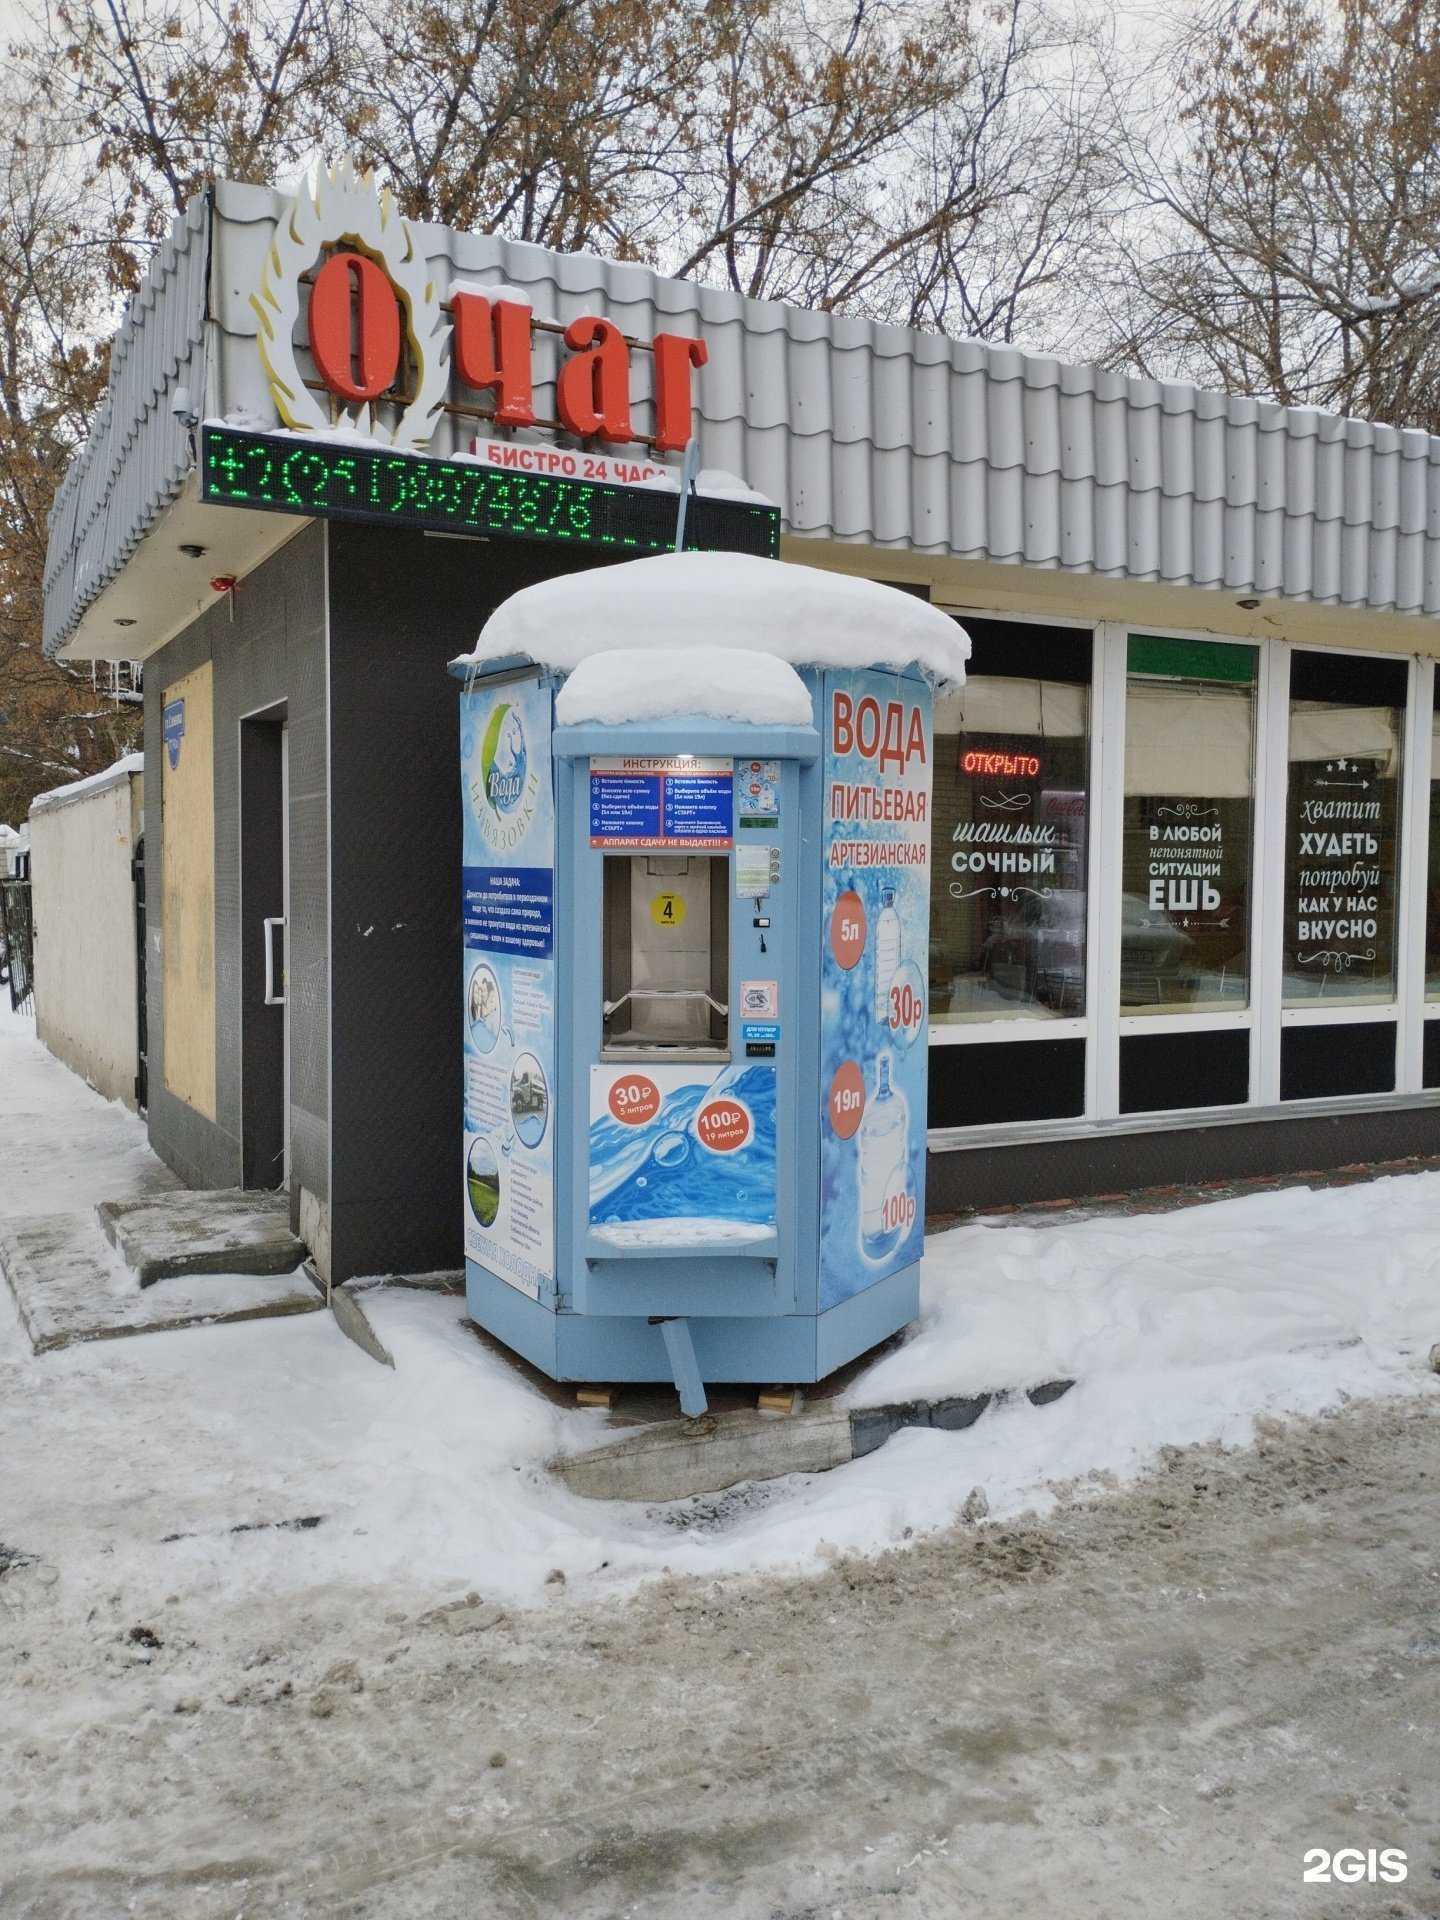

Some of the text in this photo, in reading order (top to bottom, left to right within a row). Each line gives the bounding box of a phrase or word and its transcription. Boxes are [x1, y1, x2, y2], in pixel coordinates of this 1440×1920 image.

[487, 445, 666, 483] БИСТРО 24 ЧАС
[833, 692, 926, 775] ВОДА
[623, 759, 701, 769] ИНСТРУКЦИЯ:
[964, 753, 1039, 775] ОТКРЫТО
[488, 772, 520, 805] Вода
[831, 785, 926, 822] ПИТЬЕВАЯ
[1300, 800, 1381, 824] хватит
[603, 838, 638, 847] АППАРАТ
[640, 838, 666, 847] СДАЧУ
[668, 838, 678, 847] НЕ
[953, 822, 1055, 844] шашлык
[1149, 823, 1222, 841] В ЛЮБОЙ
[830, 841, 926, 866] АРТЕЗИАНСКАЯ
[1149, 845, 1224, 859] непонятной
[1300, 833, 1378, 856] ХУДЕТЬ
[951, 848, 1055, 873] СОЧНЫЙ
[1149, 862, 1221, 877] СИТУАЦИИ
[1300, 861, 1381, 894] попробуй
[1149, 879, 1221, 910] ЕШЬ
[1298, 896, 1378, 913] КАК У НАС
[664, 900, 673, 919] 4
[841, 918, 859, 942] 5л
[1298, 918, 1378, 941] ВКУСНО
[890, 984, 922, 1030] 30р
[620, 1104, 653, 1116] 5 литров
[834, 1089, 860, 1113] 19л
[706, 1129, 744, 1142] 19 литров
[883, 1192, 915, 1231] 100р
